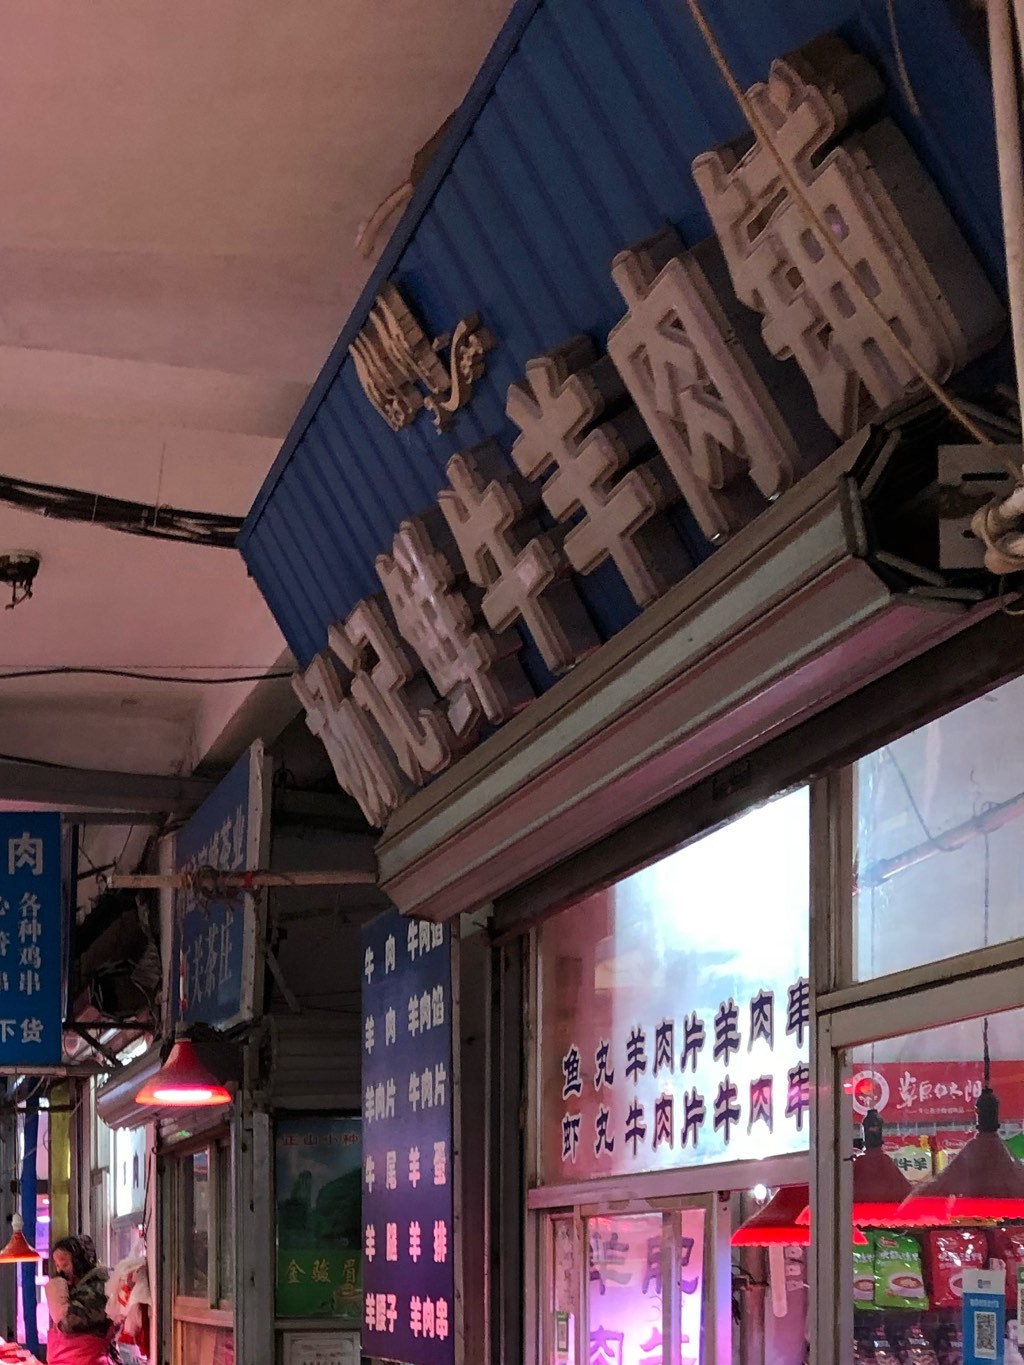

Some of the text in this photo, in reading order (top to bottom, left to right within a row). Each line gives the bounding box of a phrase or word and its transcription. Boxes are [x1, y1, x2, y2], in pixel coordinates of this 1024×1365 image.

[290, 55, 968, 828] 杨记鲜牛羊肉铺
[18, 892, 42, 995] 各种鸡串
[364, 932, 396, 985] 牛肉
[365, 985, 444, 1055] 羊肉 羊肉馅
[365, 1062, 446, 1124] 羊肉片 牛肉片
[282, 1131, 360, 1147] 正山小种
[408, 1220, 447, 1263] 羊排
[409, 1295, 448, 1340] 羊肉串
